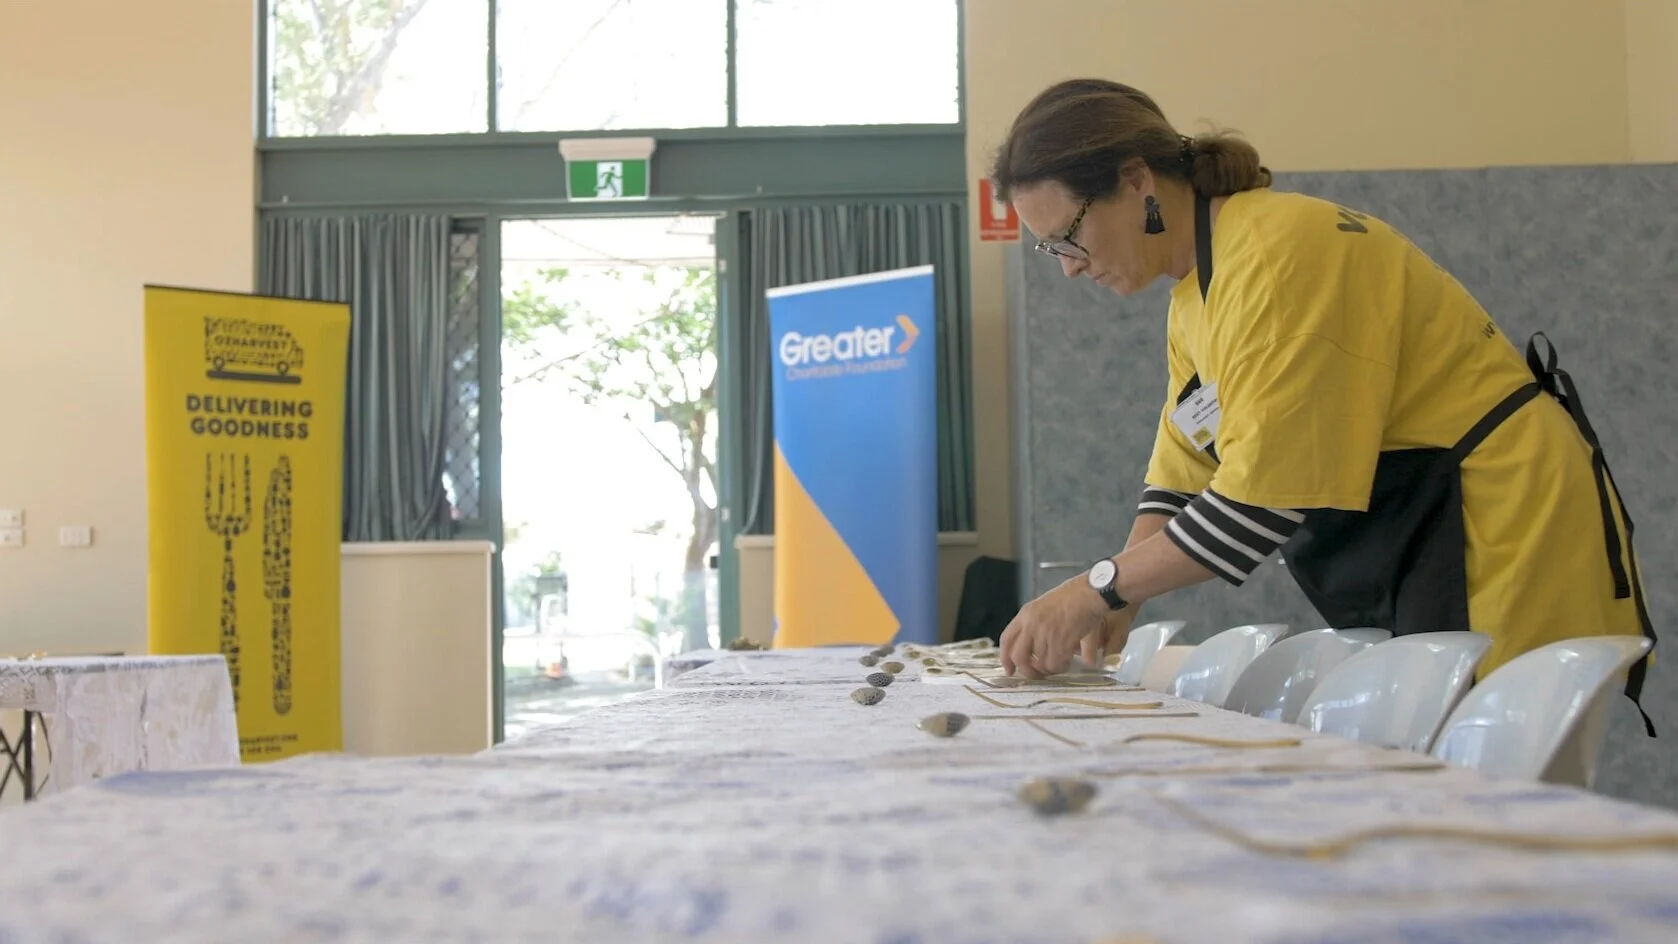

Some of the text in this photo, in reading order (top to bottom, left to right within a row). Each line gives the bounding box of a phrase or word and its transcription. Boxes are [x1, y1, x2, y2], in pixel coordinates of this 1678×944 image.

[779, 325, 895, 366] Greater
[186, 393, 313, 418] DELIVERING
[190, 416, 309, 440] GOODNESS
